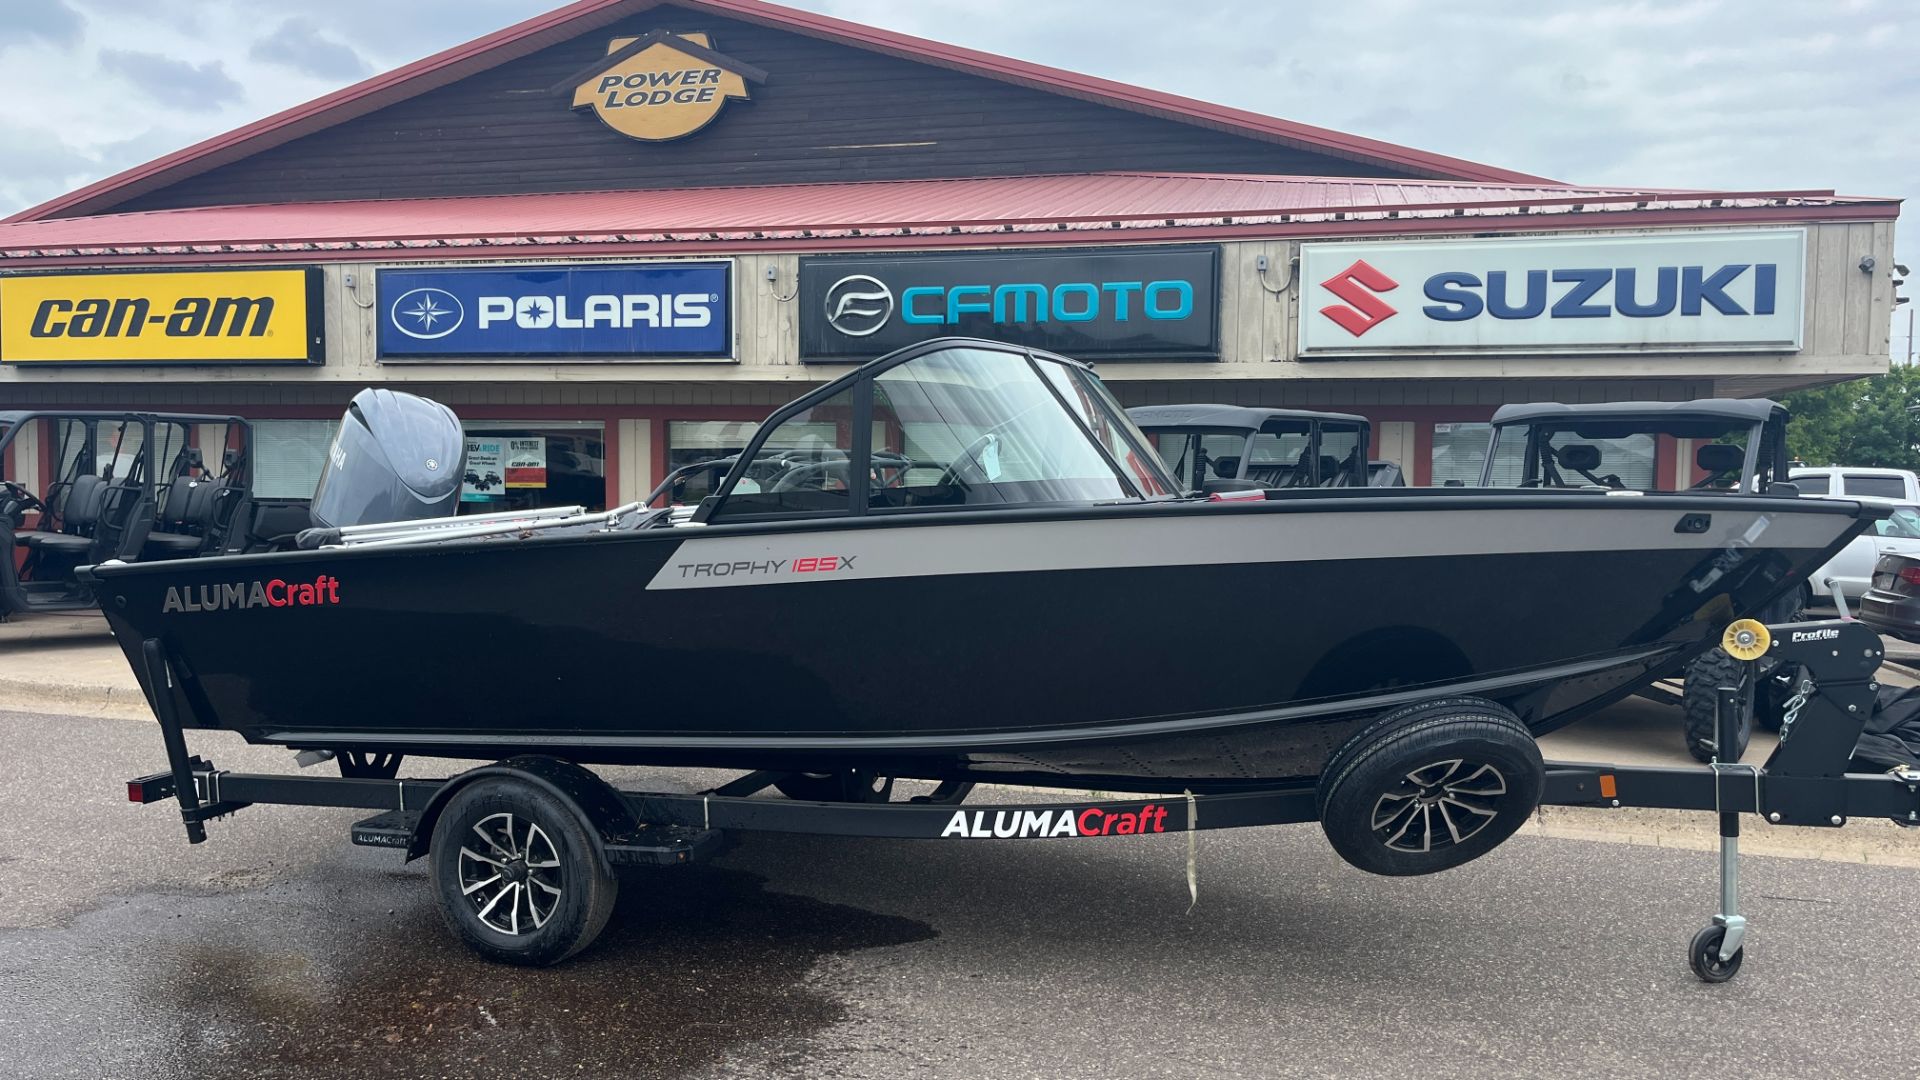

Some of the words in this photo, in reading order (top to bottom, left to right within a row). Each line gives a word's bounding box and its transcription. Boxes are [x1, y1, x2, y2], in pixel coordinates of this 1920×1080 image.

[598, 69, 721, 93] POWER
[604, 87, 717, 108] LODGE
[901, 280, 1193, 325] CFMOTO
[1422, 263, 1777, 322] SUZUKI
[30, 296, 275, 338] can-am
[478, 293, 711, 329] POLARIS
[678, 559, 787, 578] TROPHY
[791, 555, 857, 573] 185X
[162, 575, 340, 613] ALUMACraft
[1791, 629, 1840, 641] Profile
[941, 804, 1168, 838] ALUMACraft
